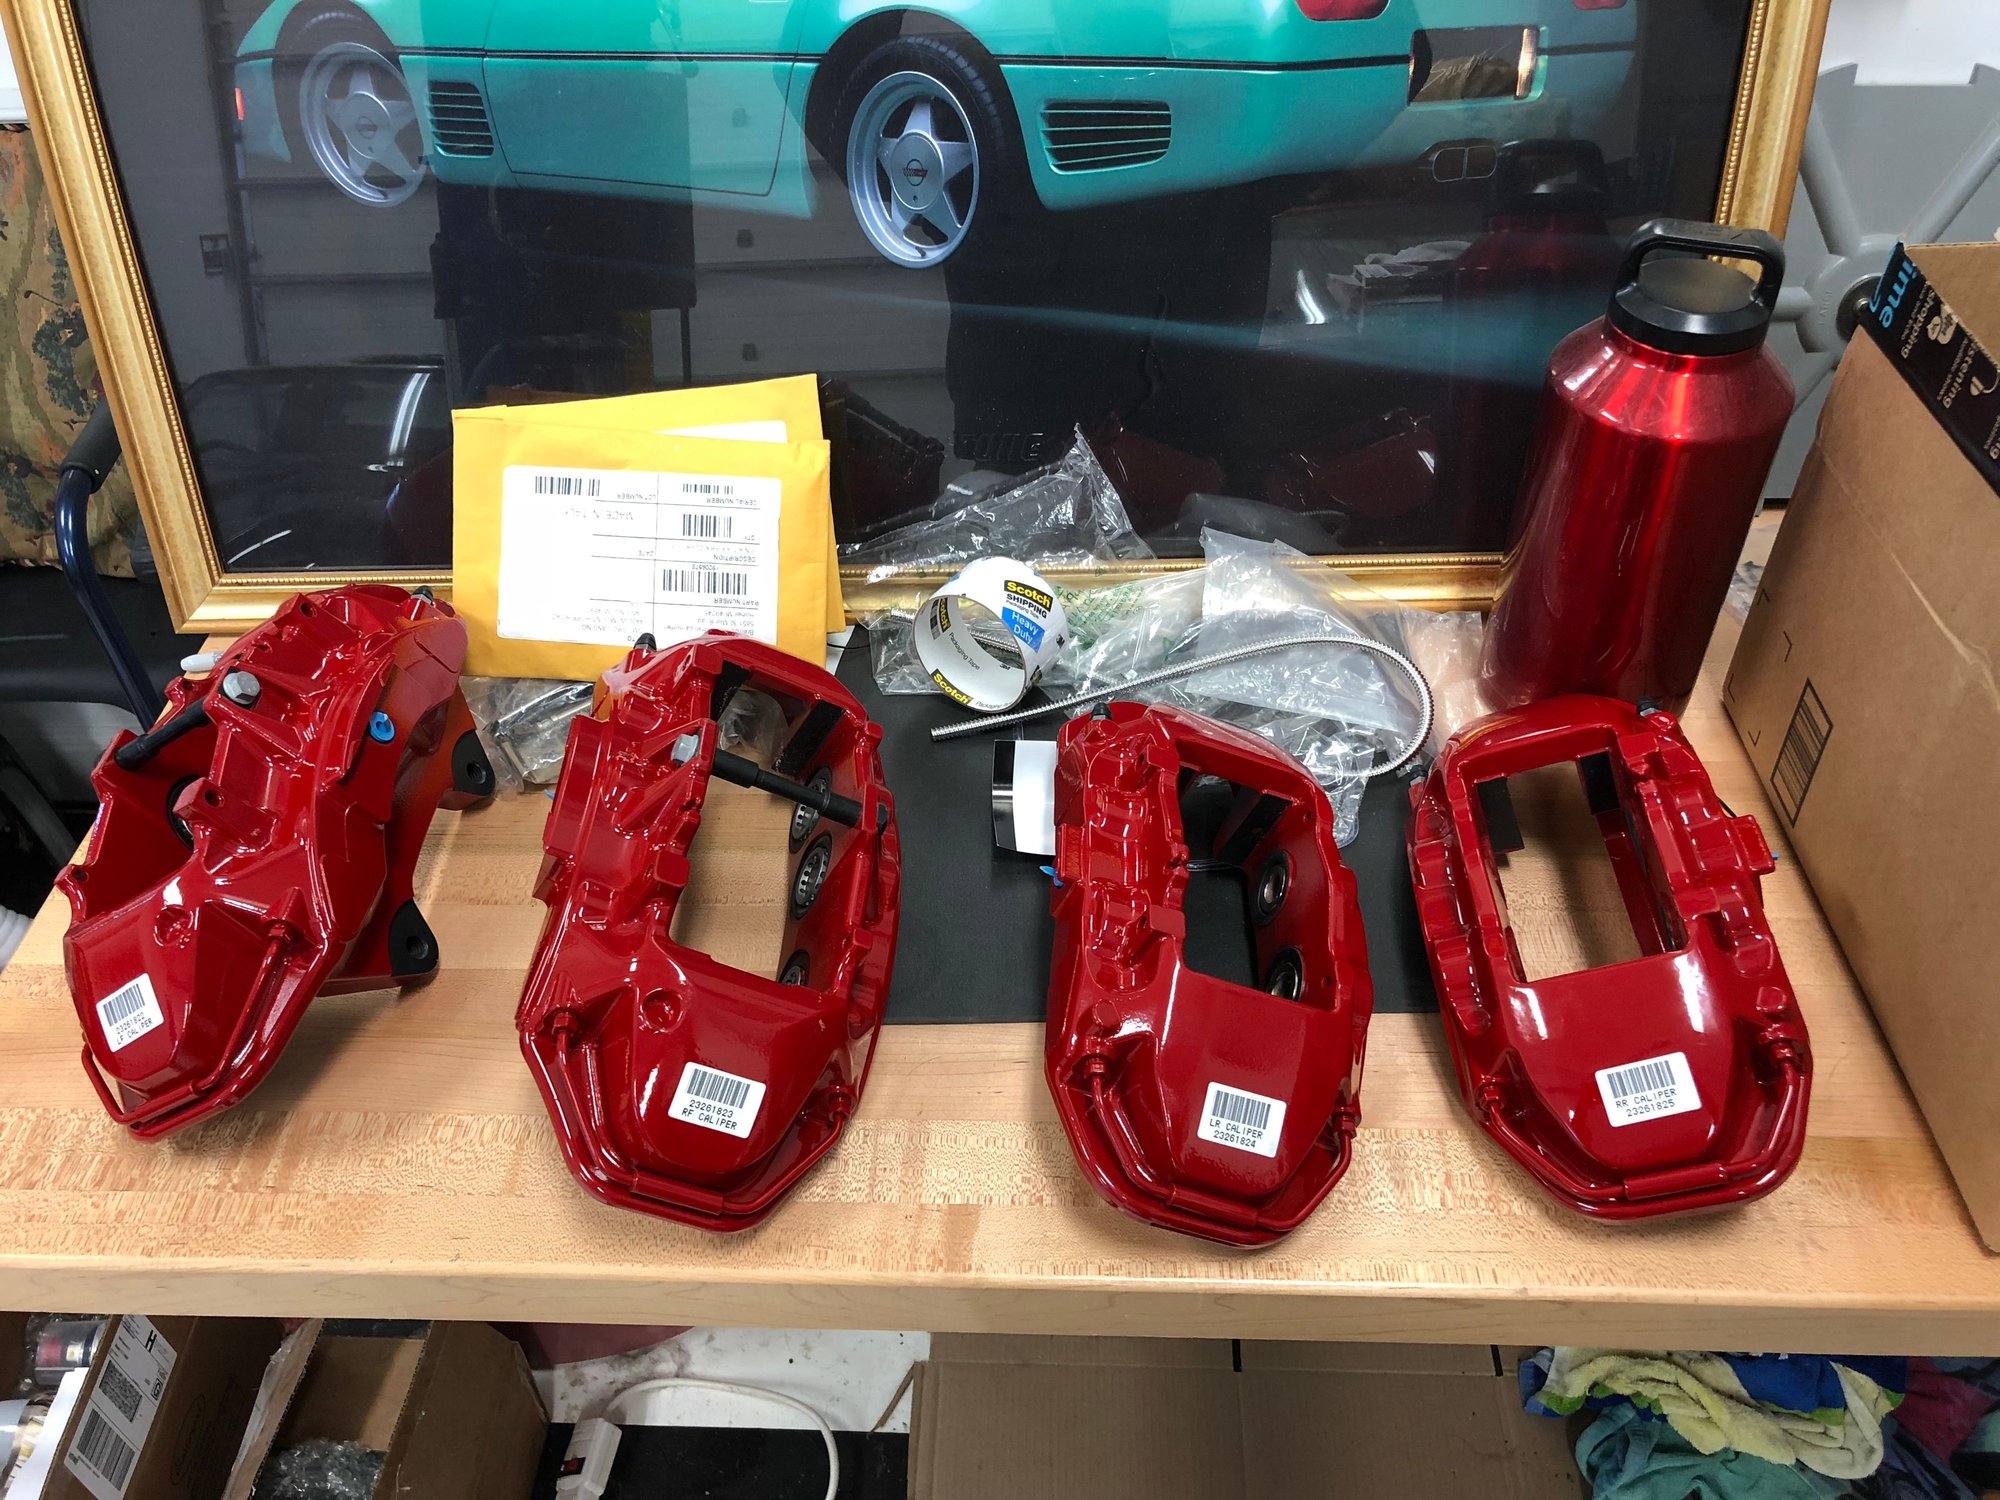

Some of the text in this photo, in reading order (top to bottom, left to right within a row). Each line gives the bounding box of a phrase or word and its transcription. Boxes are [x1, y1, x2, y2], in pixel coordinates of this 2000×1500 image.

[706, 497, 757, 506] SERIAL NUMBER
[713, 554, 756, 563] DESCRIPTION
[714, 597, 741, 605] NUMBER
[1007, 581, 1051, 607] Scotch
[940, 598, 948, 630] cotch
[1006, 593, 1047, 619] SHIPPING
[1012, 611, 1039, 634] Heavy
[1013, 624, 1034, 645] Duty
[949, 632, 981, 670] Packaging Tape
[933, 672, 970, 705] Scotch
[127, 1017, 153, 1039] CALIPER
[689, 1099, 734, 1119] 23261823
[1615, 1088, 1678, 1109] RR CALIPER
[1626, 1098, 1676, 1118] 23261825
[681, 1107, 738, 1130] RF CALIPER
[1209, 1118, 1264, 1140] LR CALIPER
[1213, 1130, 1257, 1148] 23261824
